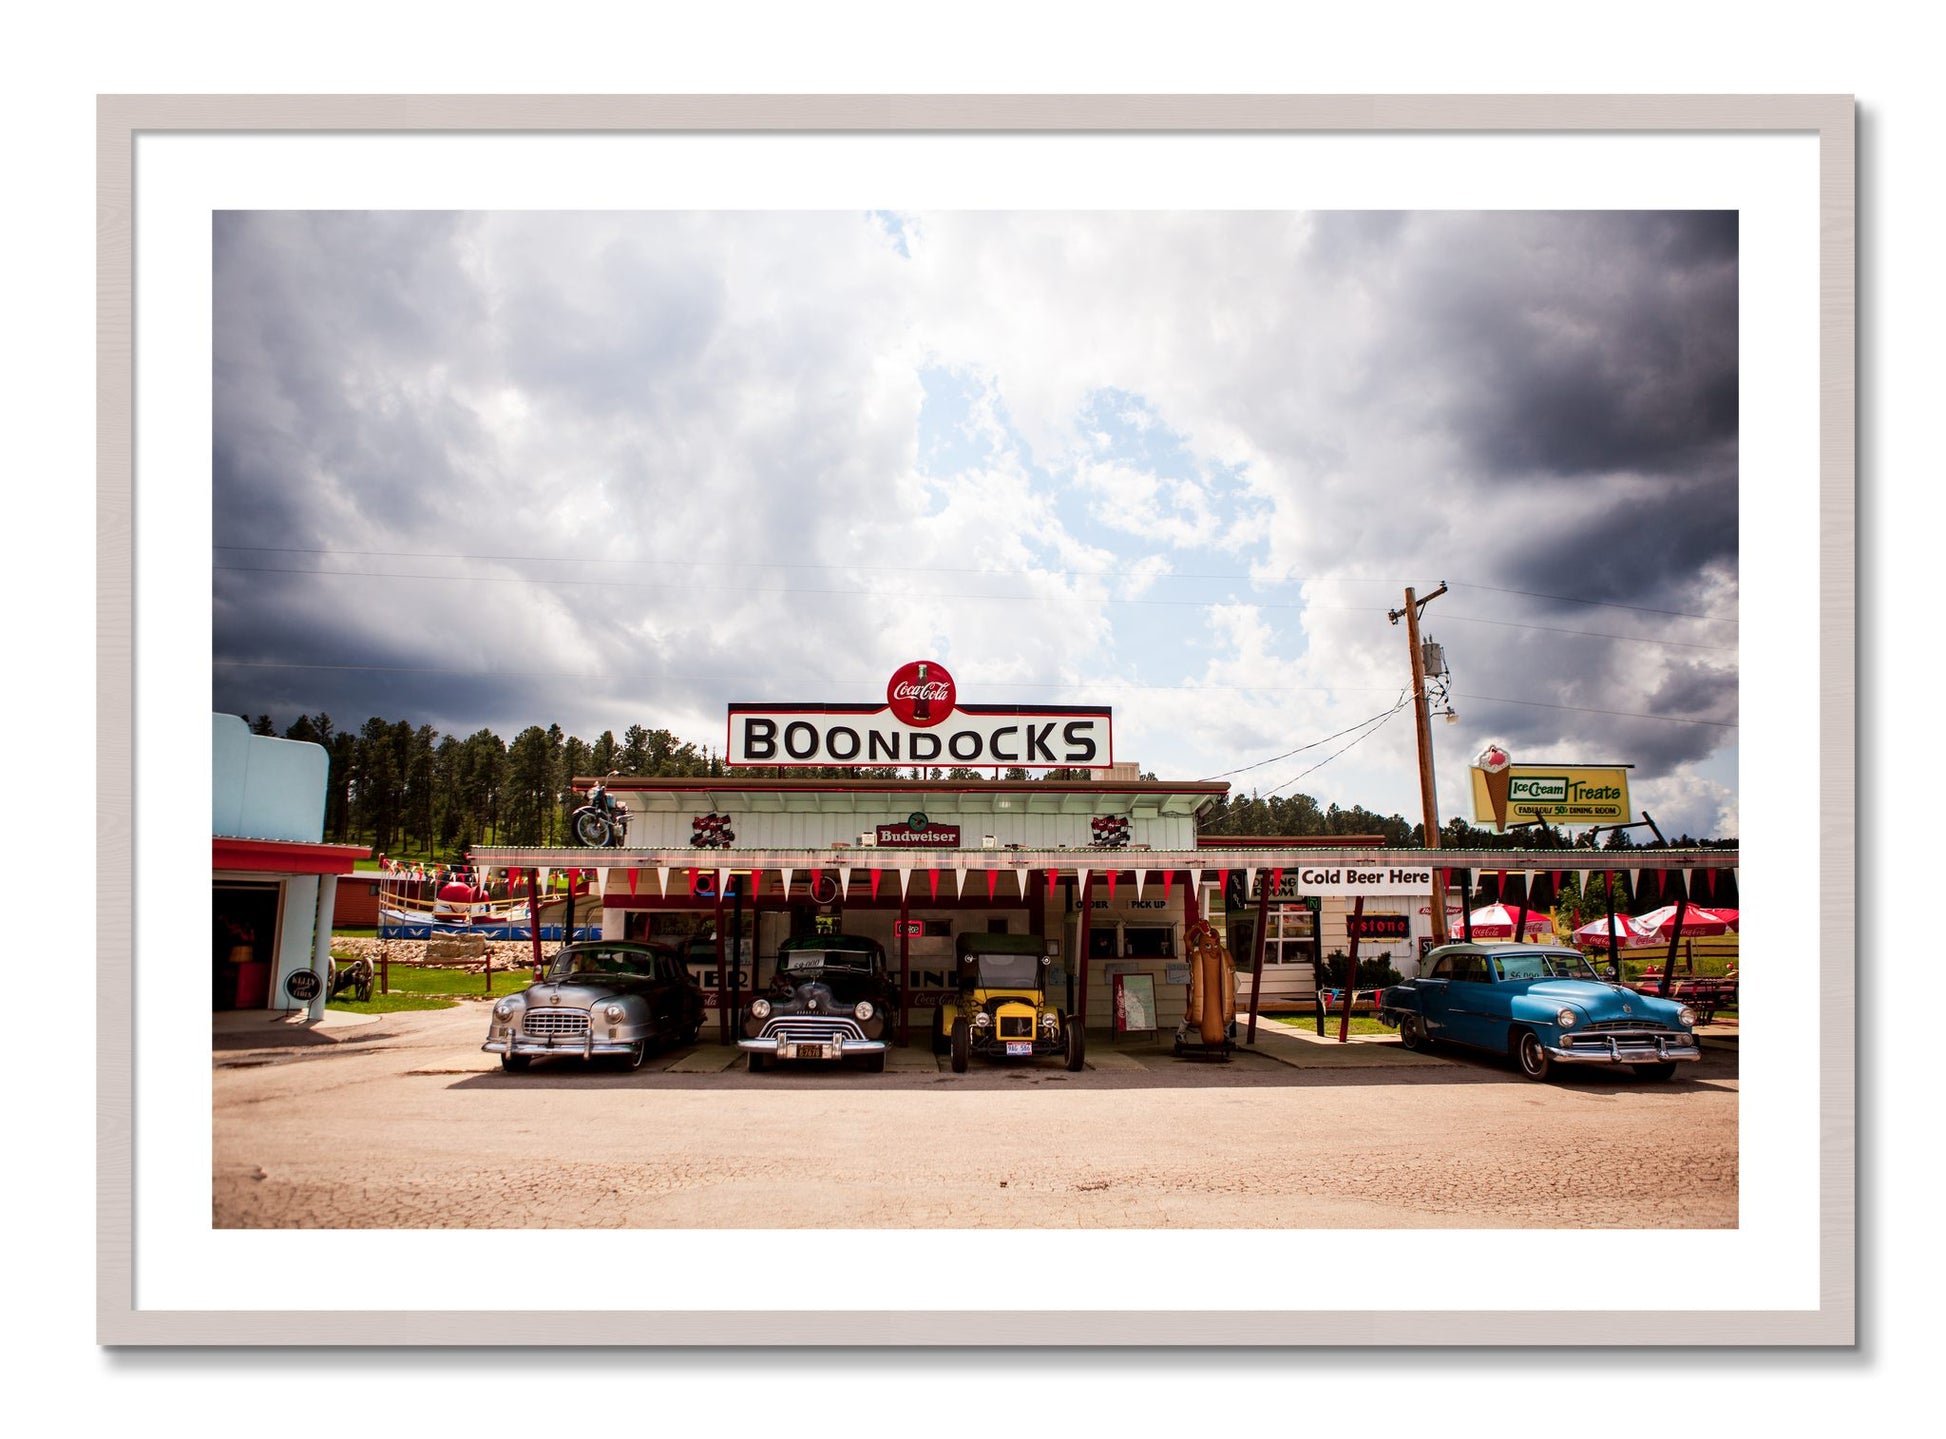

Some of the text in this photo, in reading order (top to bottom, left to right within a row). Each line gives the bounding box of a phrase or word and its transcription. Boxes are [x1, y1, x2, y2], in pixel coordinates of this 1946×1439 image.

[894, 681, 950, 702] Coca-Cola
[743, 717, 1097, 761] BOONDOCKS
[1513, 781, 1620, 802] Ice Cream Treats
[880, 830, 956, 842] Budweiser
[1302, 869, 1430, 884] Cold Beer Here
[1076, 901, 1108, 909] ODER
[1131, 900, 1166, 909] PICK UP
[1472, 927, 1499, 937] Coca-Cola
